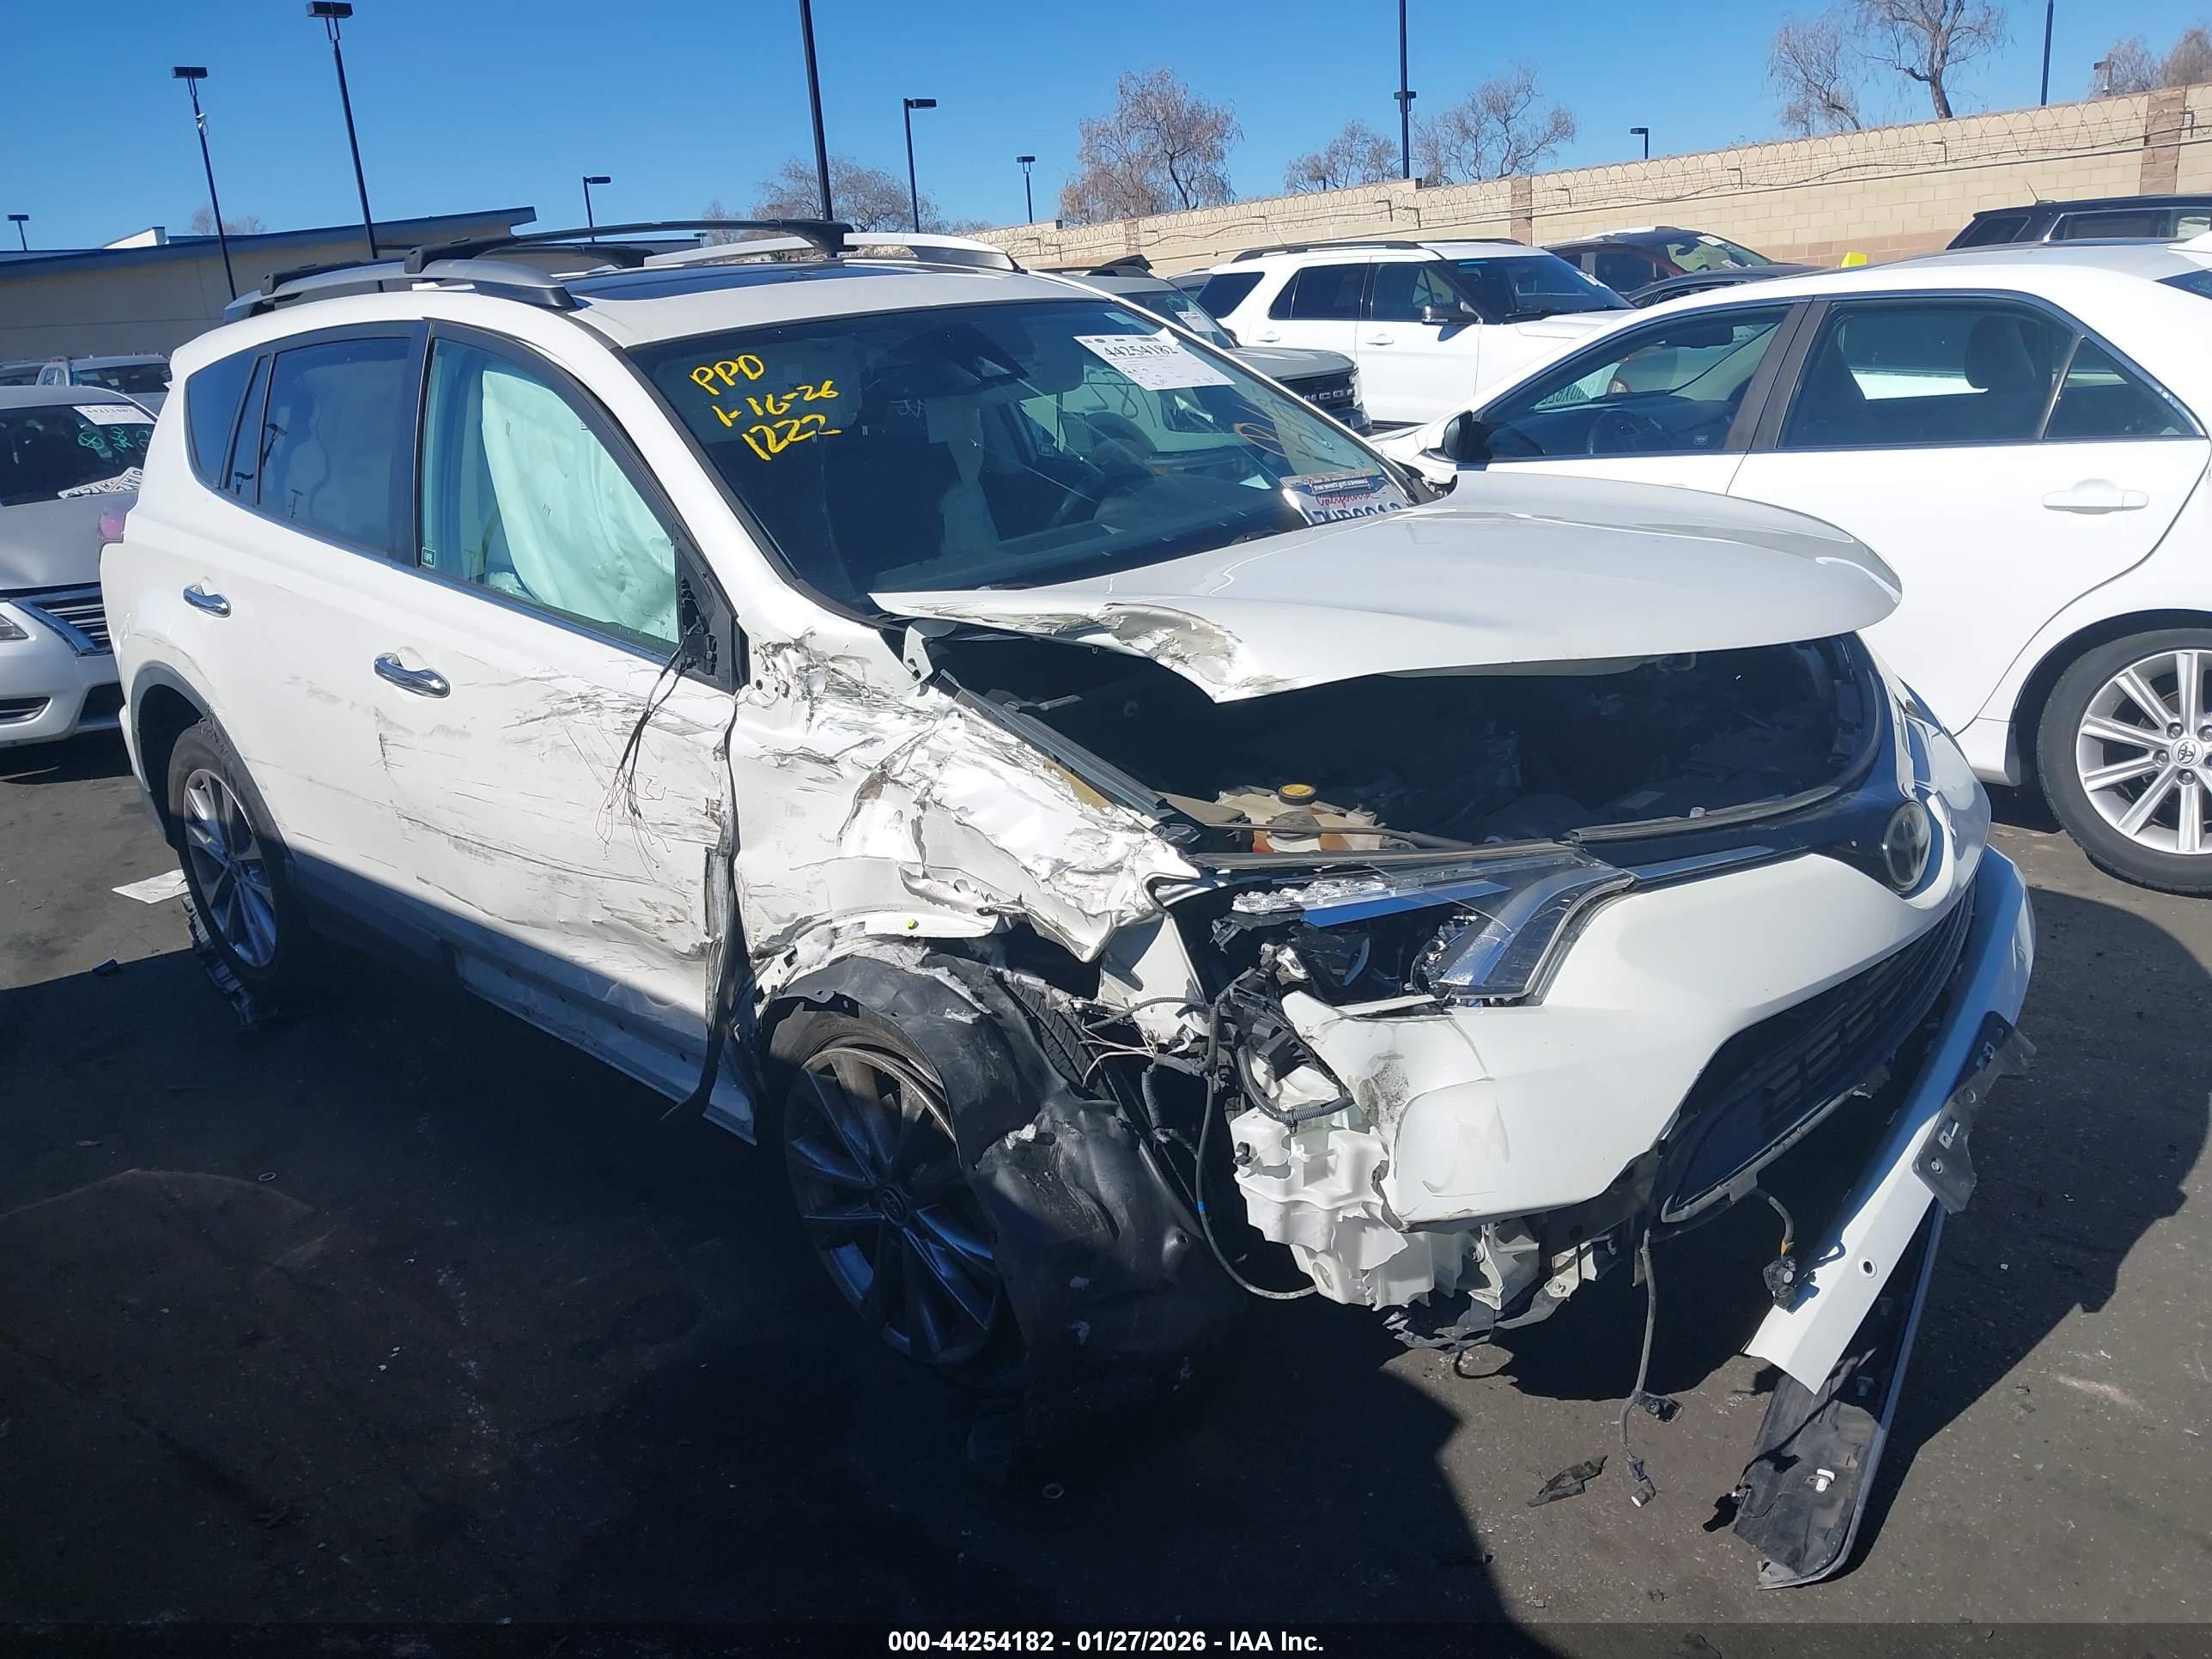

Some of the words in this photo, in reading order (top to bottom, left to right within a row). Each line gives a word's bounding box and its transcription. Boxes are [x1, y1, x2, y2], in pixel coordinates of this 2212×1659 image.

[1103, 344, 1179, 356] 44254182
[690, 354, 764, 396] PPD
[741, 413, 842, 461] 1222
